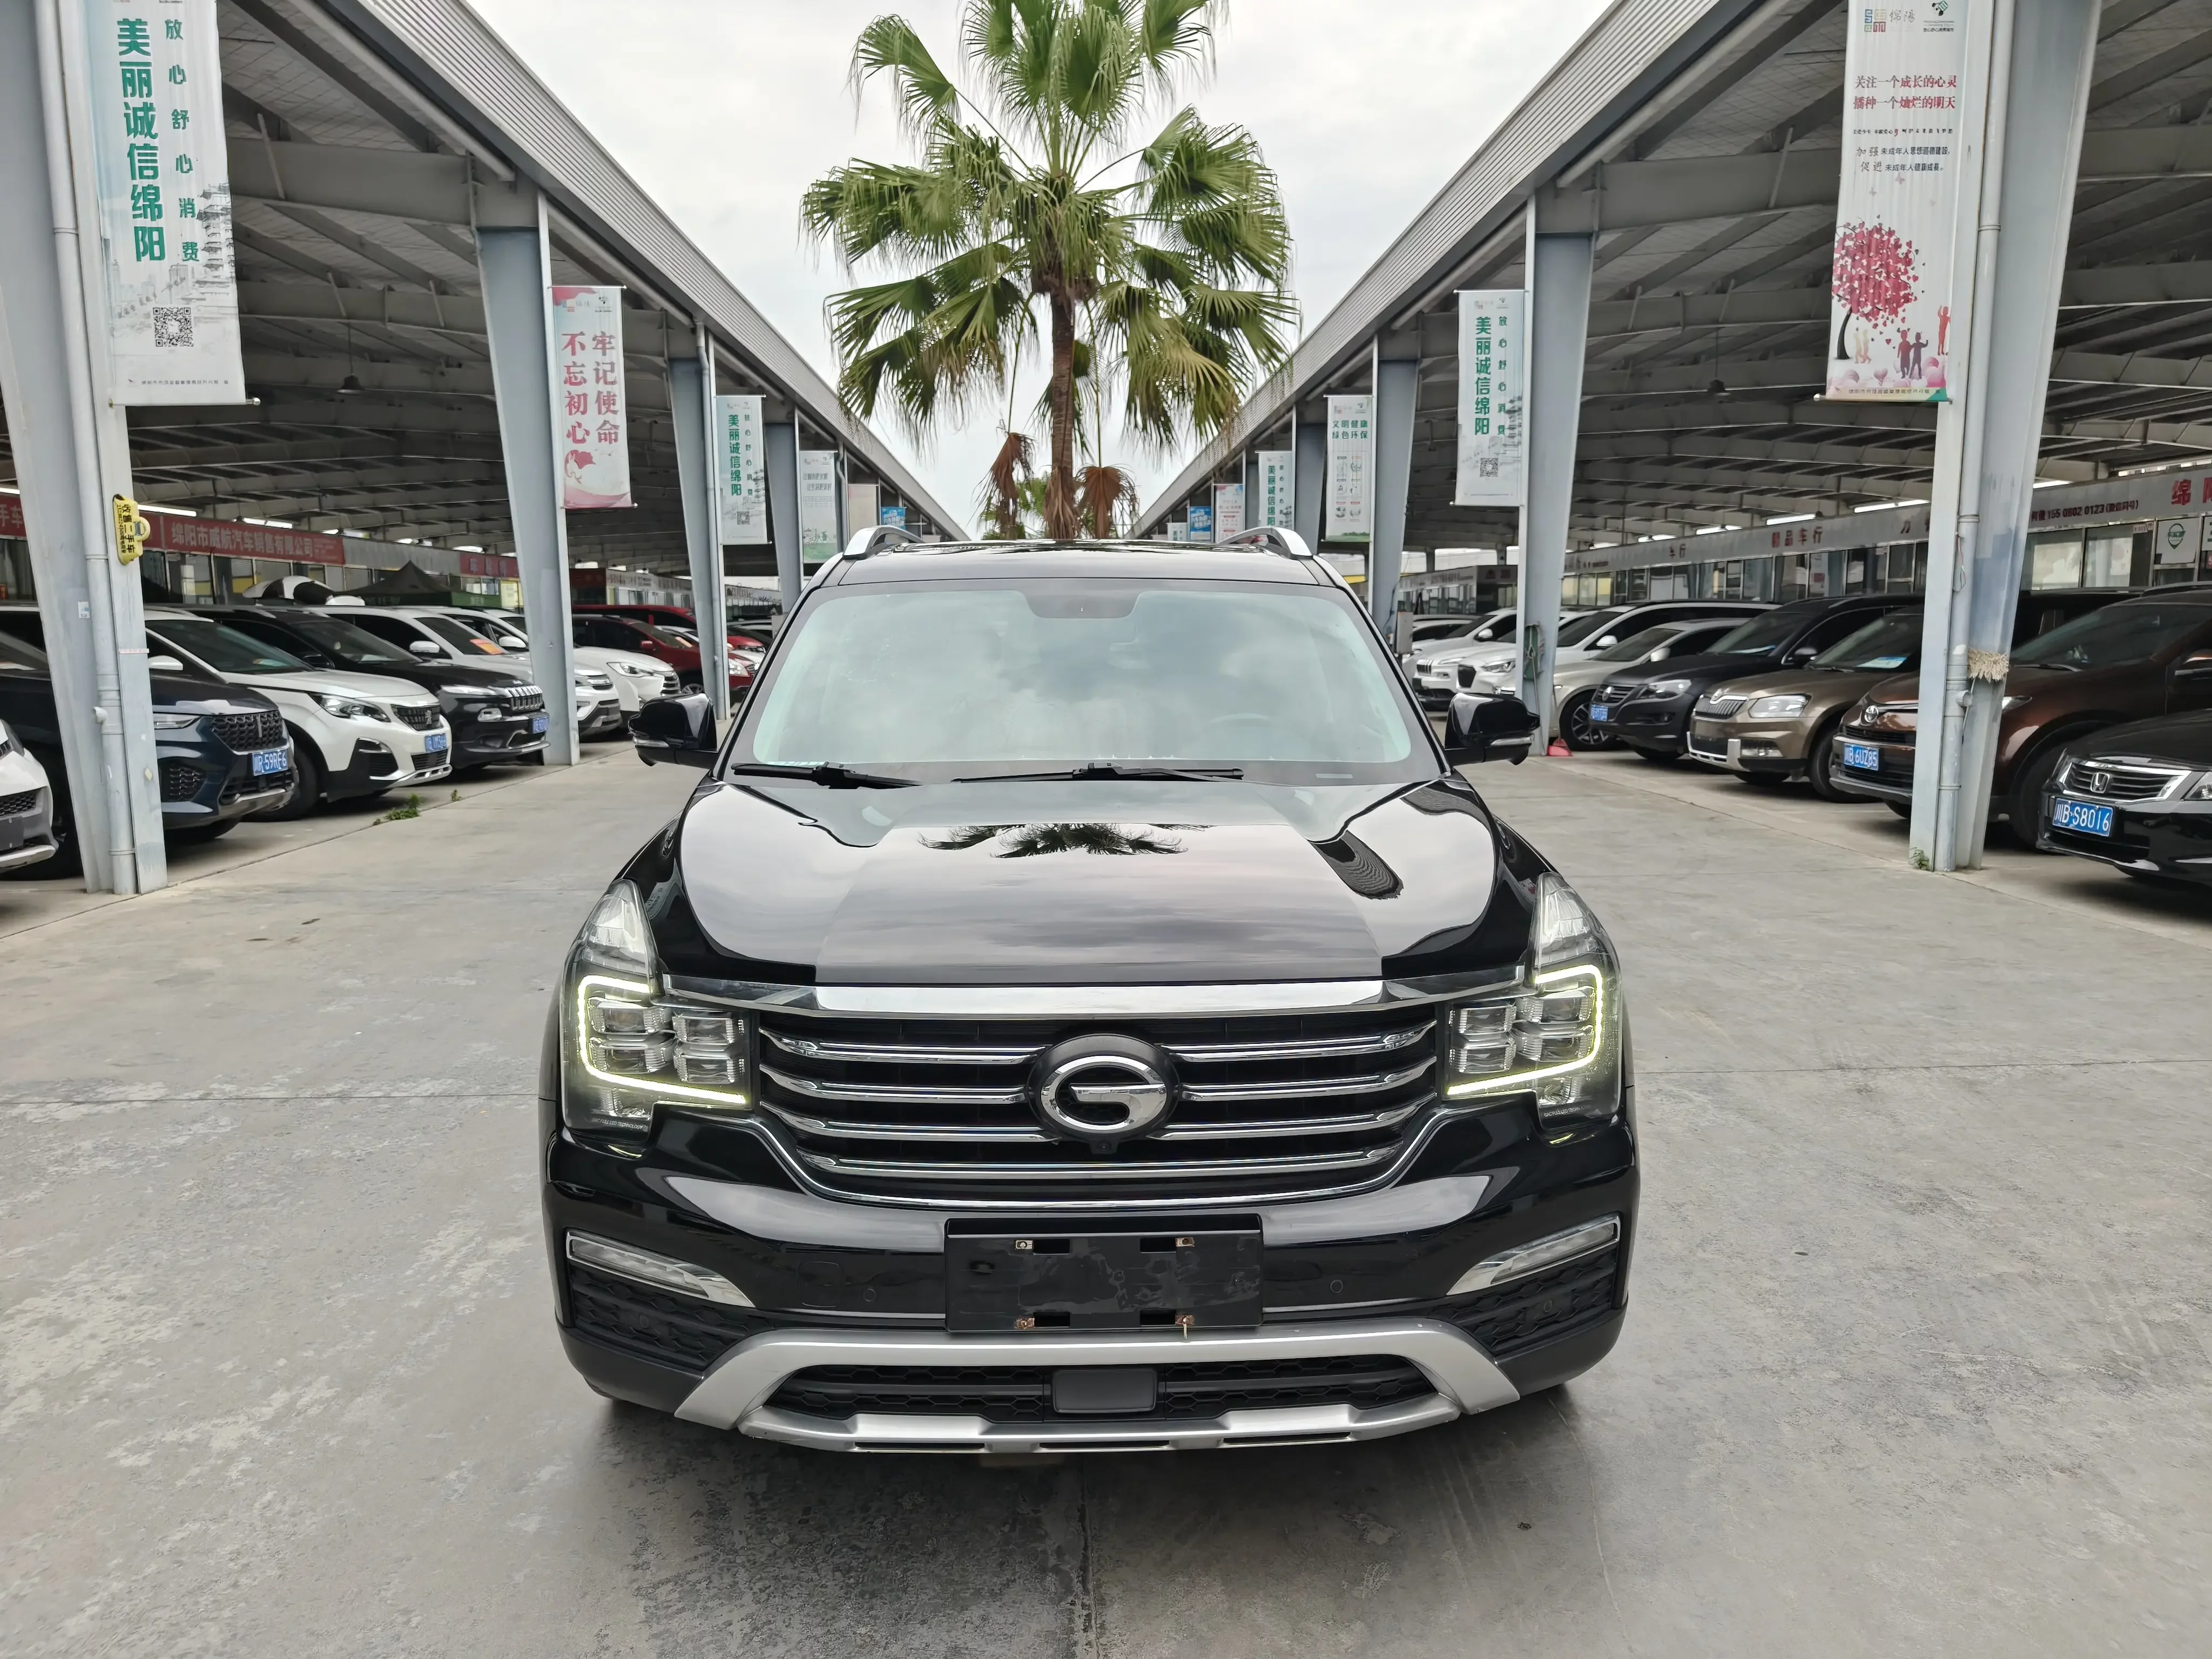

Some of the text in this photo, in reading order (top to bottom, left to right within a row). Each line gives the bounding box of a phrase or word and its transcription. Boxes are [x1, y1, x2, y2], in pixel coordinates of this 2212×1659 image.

[1853, 96, 1955, 109] 播种一个灿烂的明天
[1855, 75, 1957, 88] 关注一个成长的心灵
[117, 18, 166, 262] 美丽诚信绵阳
[165, 19, 200, 262] 放心舒心消费
[561, 331, 590, 444] 不忘初心
[592, 331, 621, 445] 牢记使命
[1474, 316, 1492, 436] 美丽诚信绵阳
[728, 414, 742, 496] 美丽诚信绵阳
